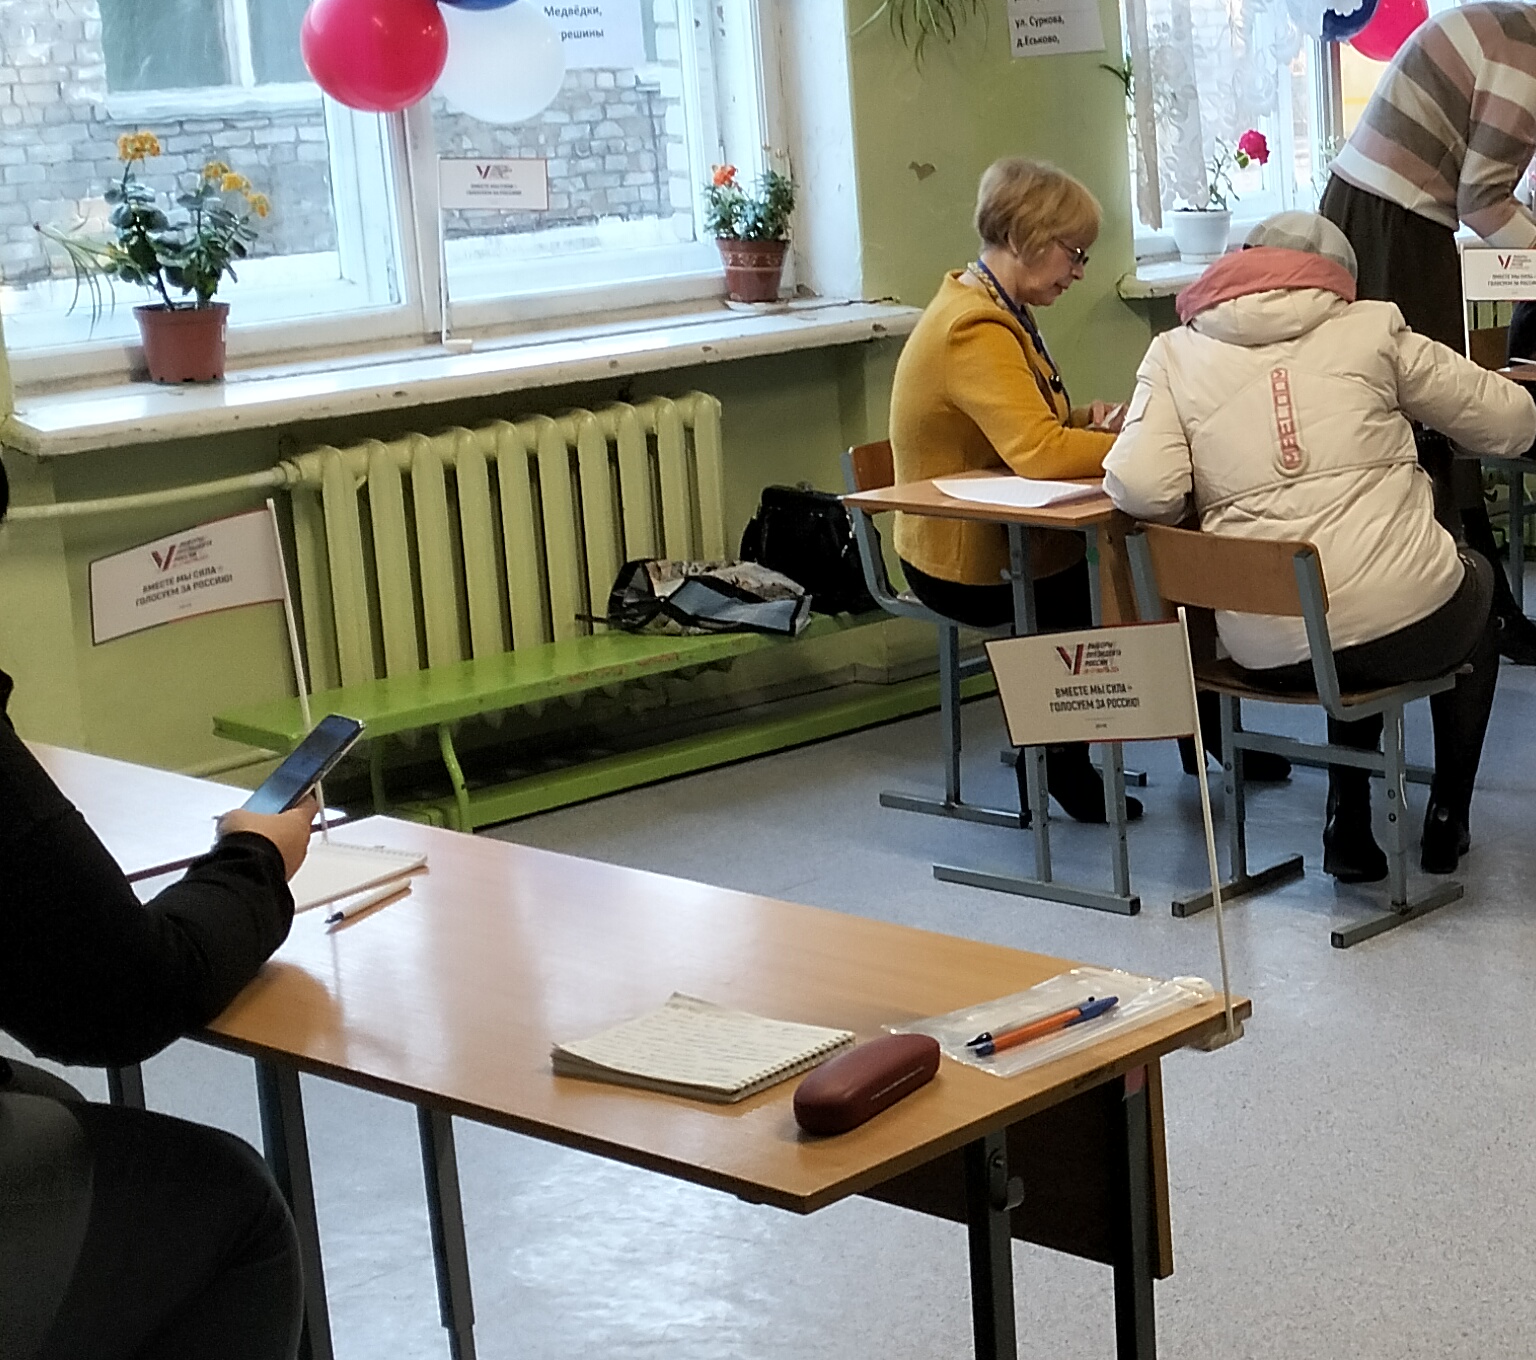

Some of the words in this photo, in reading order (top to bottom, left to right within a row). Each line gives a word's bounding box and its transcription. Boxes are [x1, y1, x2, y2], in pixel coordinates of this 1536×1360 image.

[560, 28, 605, 42] решины
[193, 566, 217, 579] СИЛА
[1055, 685, 1089, 698] ВМЕСТЕ
[1089, 684, 1105, 695] МЫ
[1105, 683, 1127, 695] СИЛА
[1049, 700, 1094, 713] ГОЛОСУЕМ
[1096, 698, 1106, 709] ЗА
